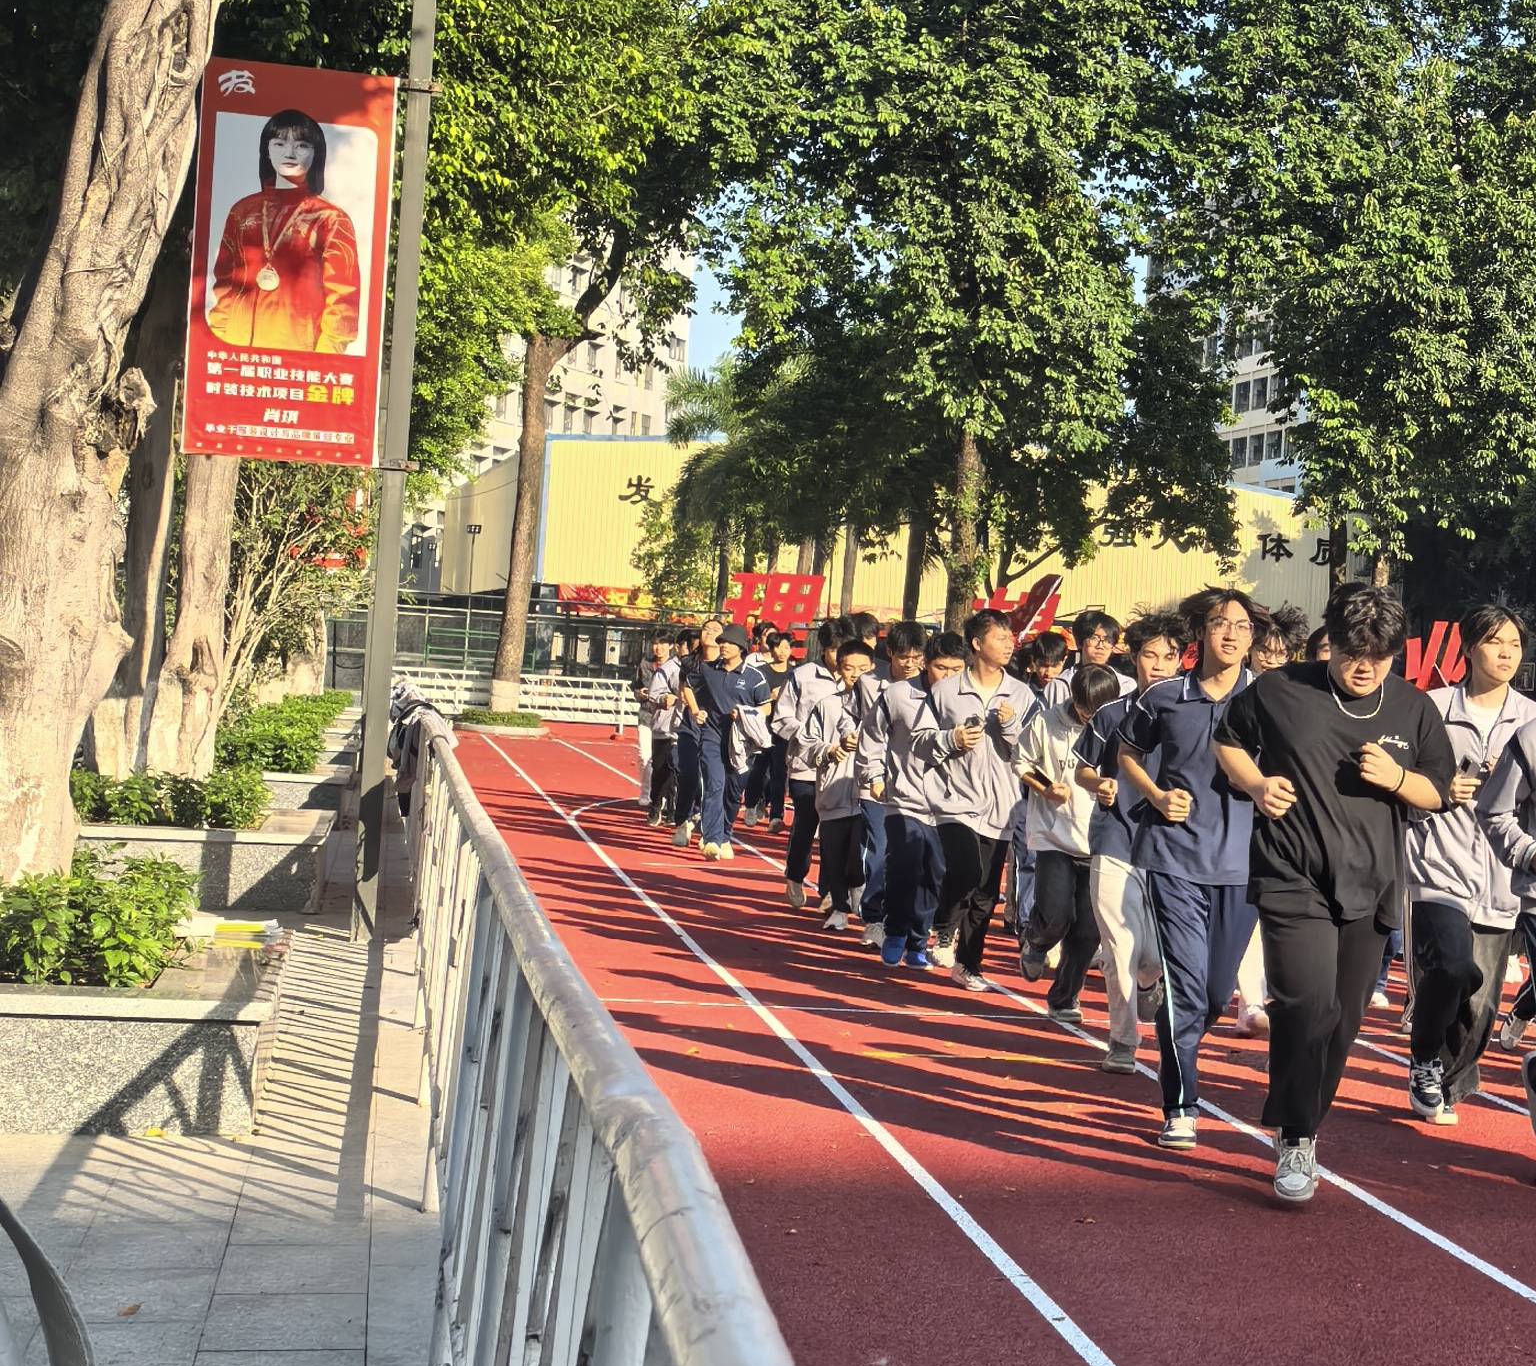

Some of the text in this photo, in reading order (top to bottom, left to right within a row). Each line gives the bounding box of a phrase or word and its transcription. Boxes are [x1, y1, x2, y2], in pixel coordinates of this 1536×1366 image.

[207, 350, 282, 366] 中华人民共和国
[206, 362, 354, 386] 第一届职业技能大赛
